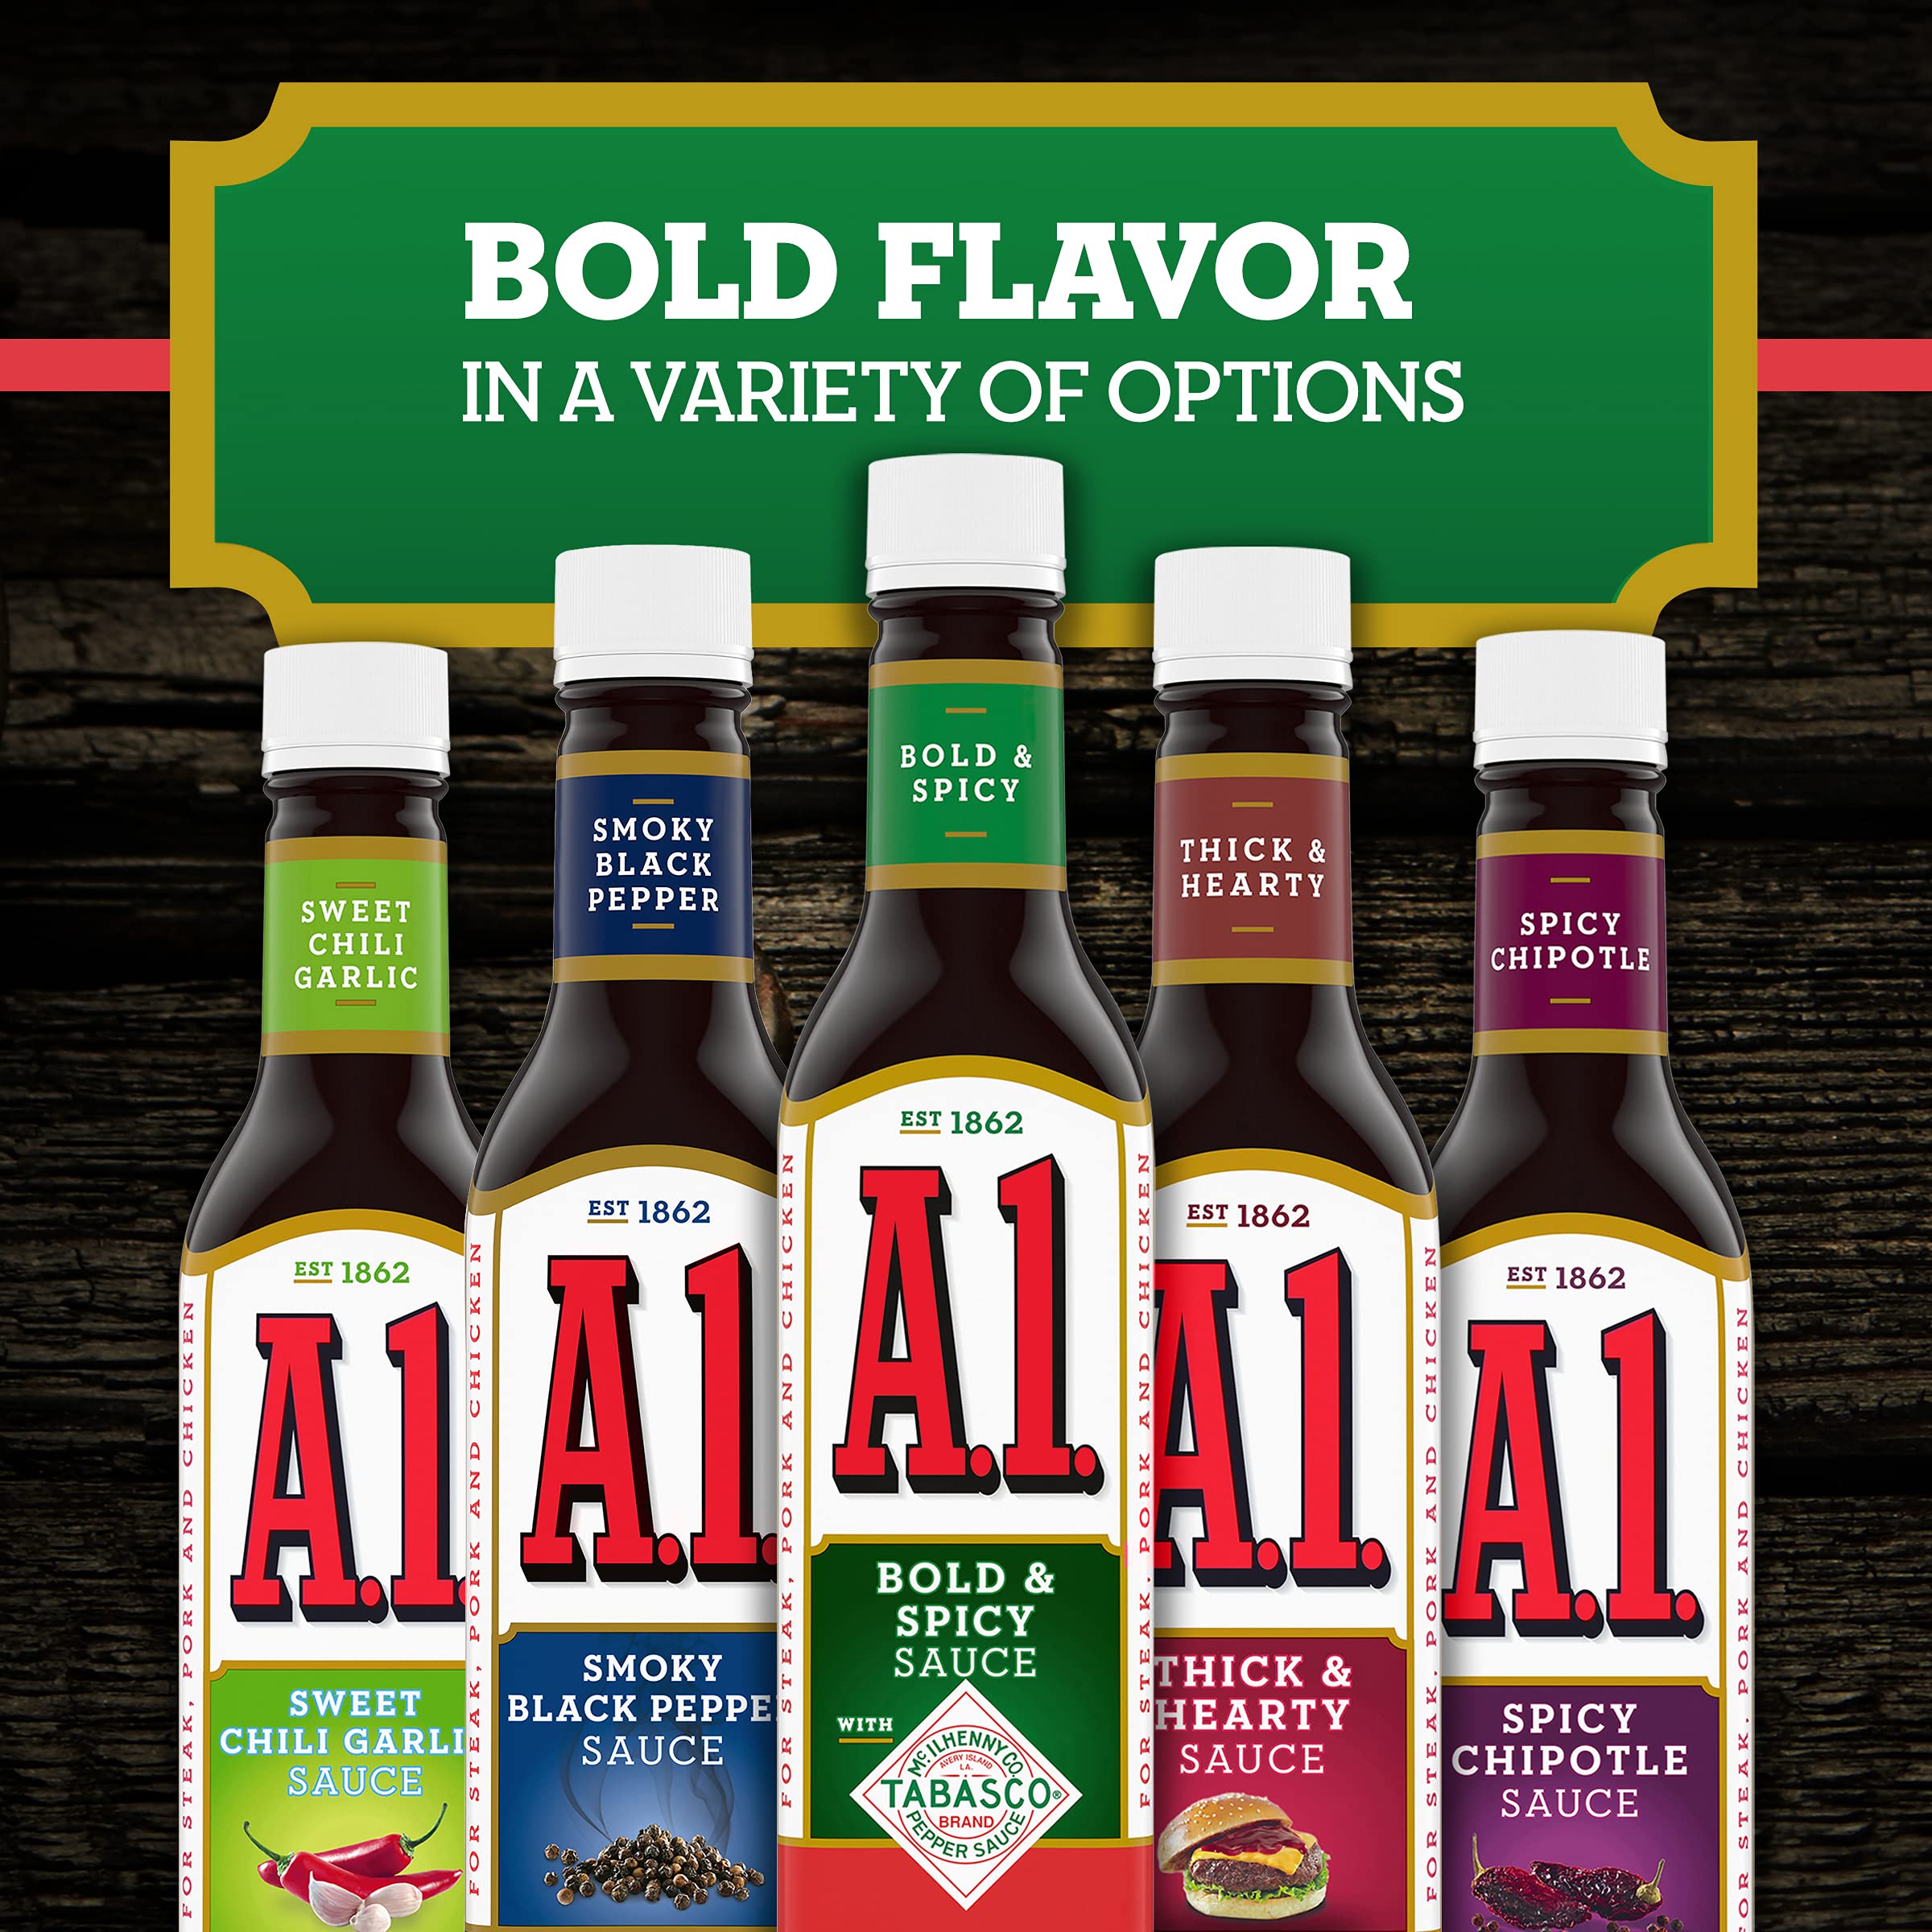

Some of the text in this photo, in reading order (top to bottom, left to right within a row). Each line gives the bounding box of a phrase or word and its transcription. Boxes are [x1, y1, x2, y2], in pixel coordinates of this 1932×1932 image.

[464, 221, 1413, 321] BOLD FLAVOR
[462, 360, 1464, 423] IN A VARIETY OF OPTIONS
[900, 743, 1033, 768] BOLD &
[913, 778, 1020, 803] SPICY
[592, 816, 714, 842] SMOKY
[596, 852, 712, 877] BLACK
[1180, 837, 1327, 863] THICK &
[588, 886, 719, 912] PEPPER
[1181, 872, 1325, 898] HEARTY
[300, 900, 411, 923] SWEET
[1519, 911, 1621, 937] SPICY
[308, 932, 404, 956] CHILI
[1490, 945, 1650, 972] CHIPOTLE
[294, 965, 419, 989] GARLIC
[901, 1111, 1023, 1134] EST 1862
[588, 1200, 711, 1224] EST 1862
[1187, 1204, 1310, 1228] EST 1862
[782, 1154, 794, 1330] CHICKEN
[1137, 1153, 1151, 1330] CHICKEN
[295, 1261, 410, 1284] EST 1862
[1508, 1267, 1626, 1290] EST 1862
[469, 1243, 481, 1418] CHICKEN
[1424, 1246, 1437, 1423] CHICKEN
[183, 1302, 194, 1468] CHICKEN
[782, 1352, 793, 1430] AND
[1138, 1352, 1151, 1430] AND
[1736, 1307, 1749, 1479] CHICKEN
[469, 1442, 481, 1520] AND
[1425, 1446, 1437, 1523] AND
[781, 1453, 793, 1554] PORK
[1138, 1452, 1151, 1554] PORK
[182, 1488, 193, 1563] AND
[1737, 1501, 1749, 1575] AND
[469, 1541, 481, 1642] PORK
[877, 1562, 1055, 1594] BOLD &
[1425, 1546, 1437, 1648] PORK
[182, 1583, 193, 1679] PORK
[896, 1605, 1035, 1637] SPICY
[894, 1647, 1036, 1678] SAUCE
[1737, 1598, 1749, 1696] PORK
[583, 1654, 723, 1682] SMOKY
[1154, 1655, 1352, 1687] THICK &
[290, 1690, 421, 1716] SWEET
[508, 1695, 778, 1722] BLACK PEPPE
[1156, 1699, 1350, 1730] HEARTY
[1503, 1703, 1637, 1734] SPICY
[837, 1717, 893, 1732] WITH
[220, 1728, 464, 1754] CHILI GARLI
[582, 1736, 724, 1765] SAUCE
[781, 1736, 792, 1809] FOR
[939, 1753, 993, 1770] AVERY ISLAND
[1139, 1737, 1151, 1809] FOR
[1180, 1744, 1324, 1774] SAUCE
[1452, 1744, 1687, 1776] CHIPOTLE
[288, 1767, 423, 1796] SAUCE
[1501, 1789, 1638, 1818] SAUCE
[906, 1810, 1026, 1859] PEPPER SAUCE
[939, 1815, 994, 1828] BRAND
[469, 1824, 480, 1897] FOR
[1426, 1831, 1438, 1902] FOR
[181, 1851, 192, 1919] FOR
